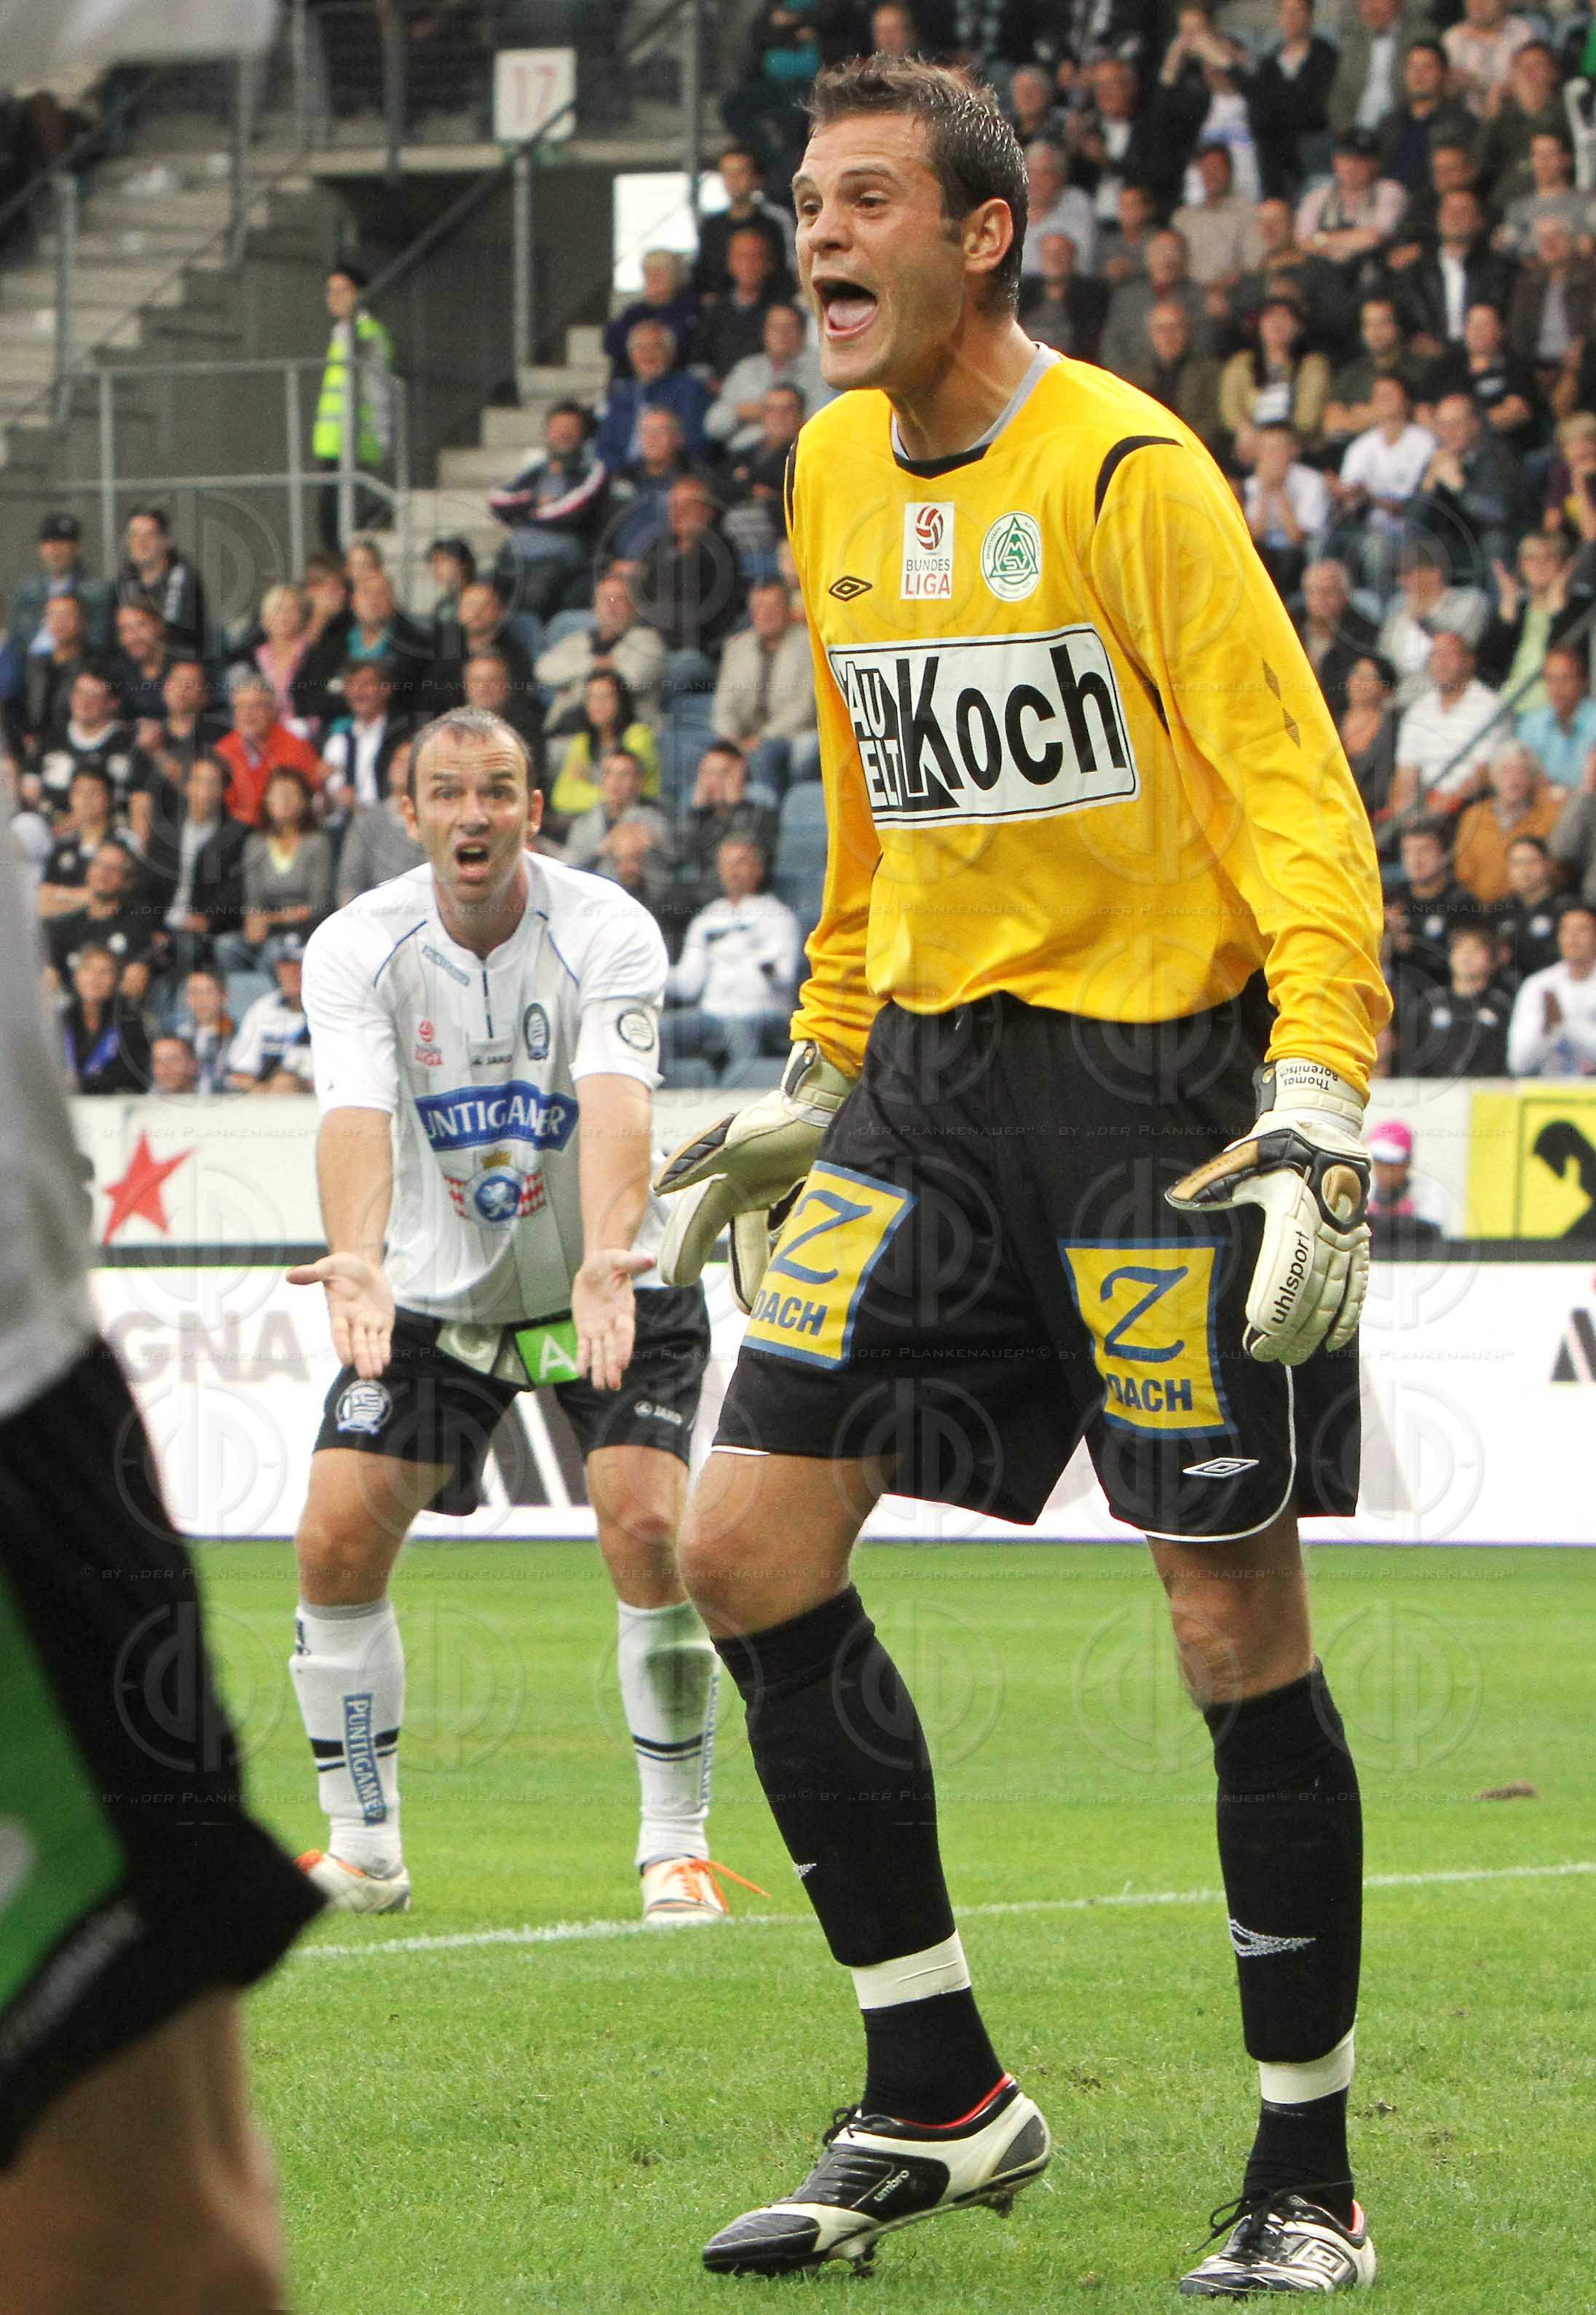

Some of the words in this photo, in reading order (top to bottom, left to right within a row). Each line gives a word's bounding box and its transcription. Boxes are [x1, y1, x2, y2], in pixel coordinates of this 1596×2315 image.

[513, 65, 556, 125] 17
[905, 573, 950, 595] LIGA
[906, 559, 950, 572] BUNDES
[845, 660, 886, 738] AU
[896, 644, 1128, 794] Koch
[1284, 1076, 1330, 1091] Thomas
[1271, 1231, 1310, 1325] uhlsport
[1100, 1266, 1188, 1363] Z
[1105, 1372, 1193, 1412] DACH
[874, 2170, 909, 2201] umbro
